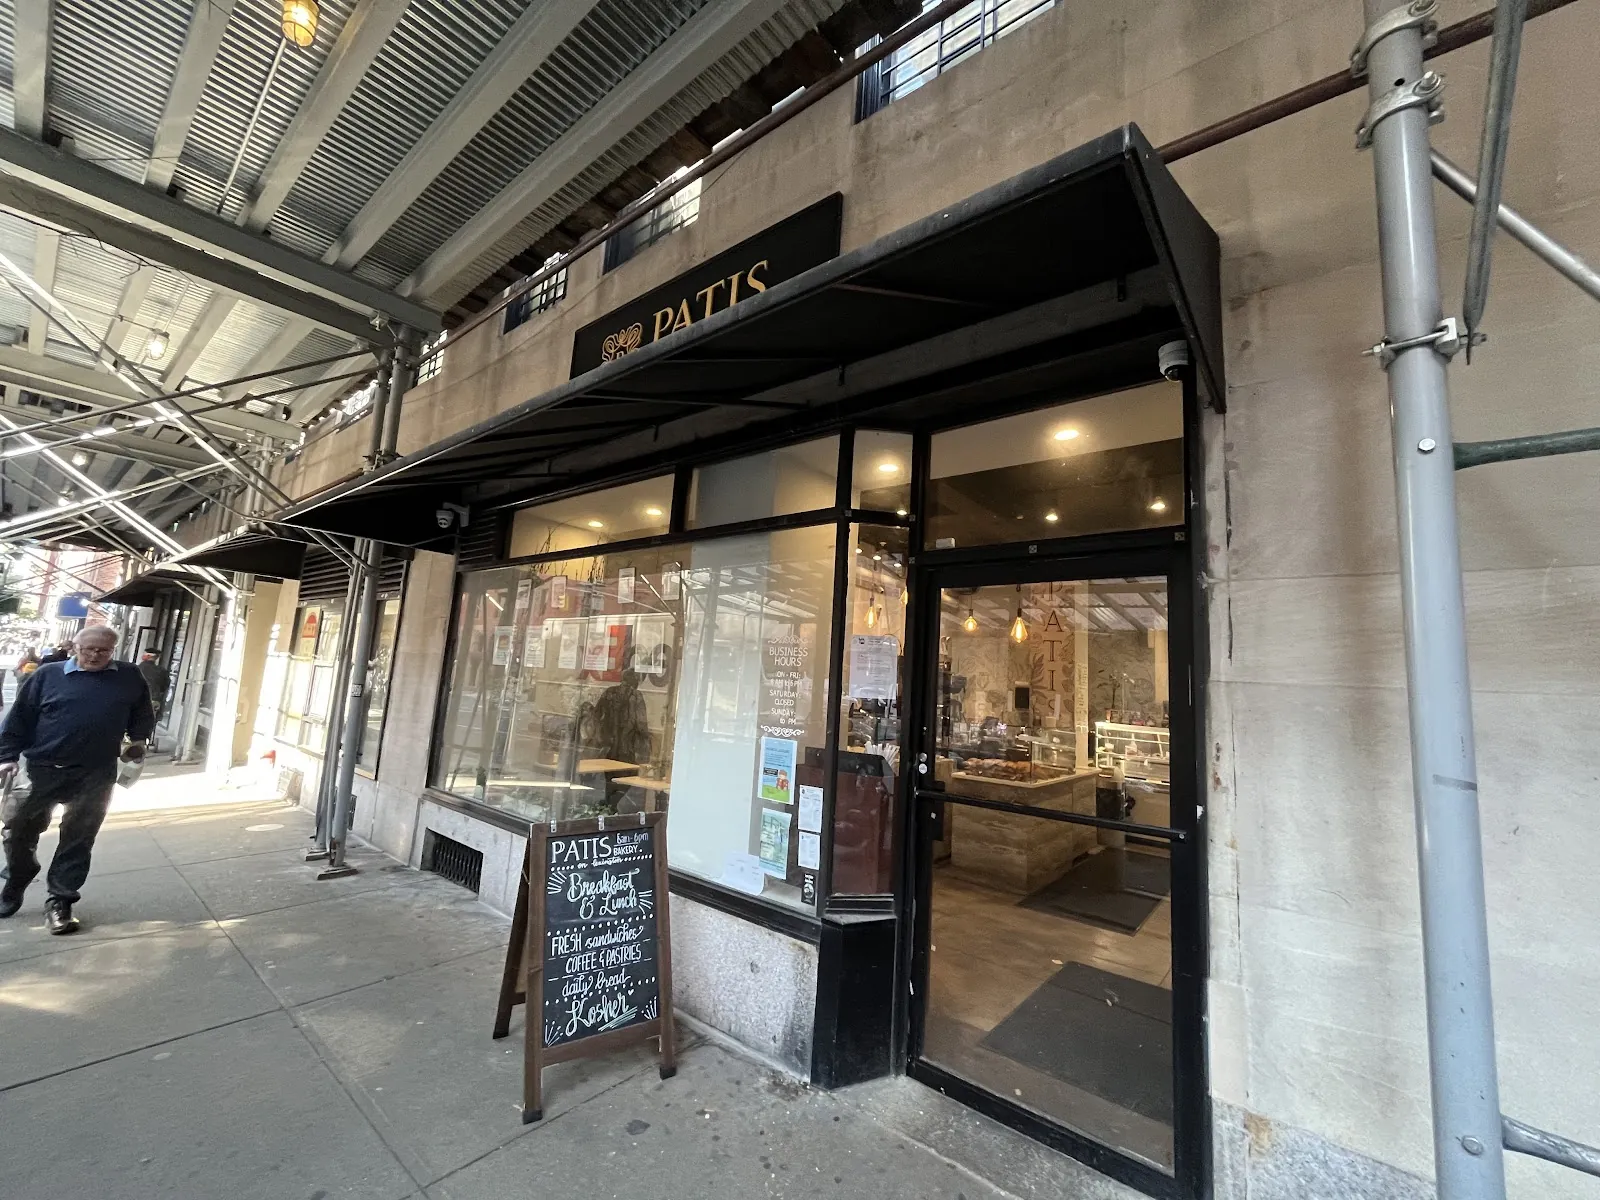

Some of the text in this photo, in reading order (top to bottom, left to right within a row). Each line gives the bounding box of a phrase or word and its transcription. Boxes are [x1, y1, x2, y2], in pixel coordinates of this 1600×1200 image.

[653, 260, 769, 342] PATIS
[769, 646, 809, 657] BUSINESS
[774, 656, 802, 667] HOURS
[774, 698, 795, 706] CLOSED
[551, 836, 612, 863] PATIS
[613, 845, 639, 856] BAKERY
[567, 868, 640, 902] Breakfast
[599, 888, 637, 915] Lunch
[551, 923, 644, 956] FRESH sandwiches
[565, 952, 598, 973] COFFEE
[606, 943, 642, 967] PASTRIES
[562, 968, 631, 996] daily bread
[565, 992, 629, 1036] Kosher
